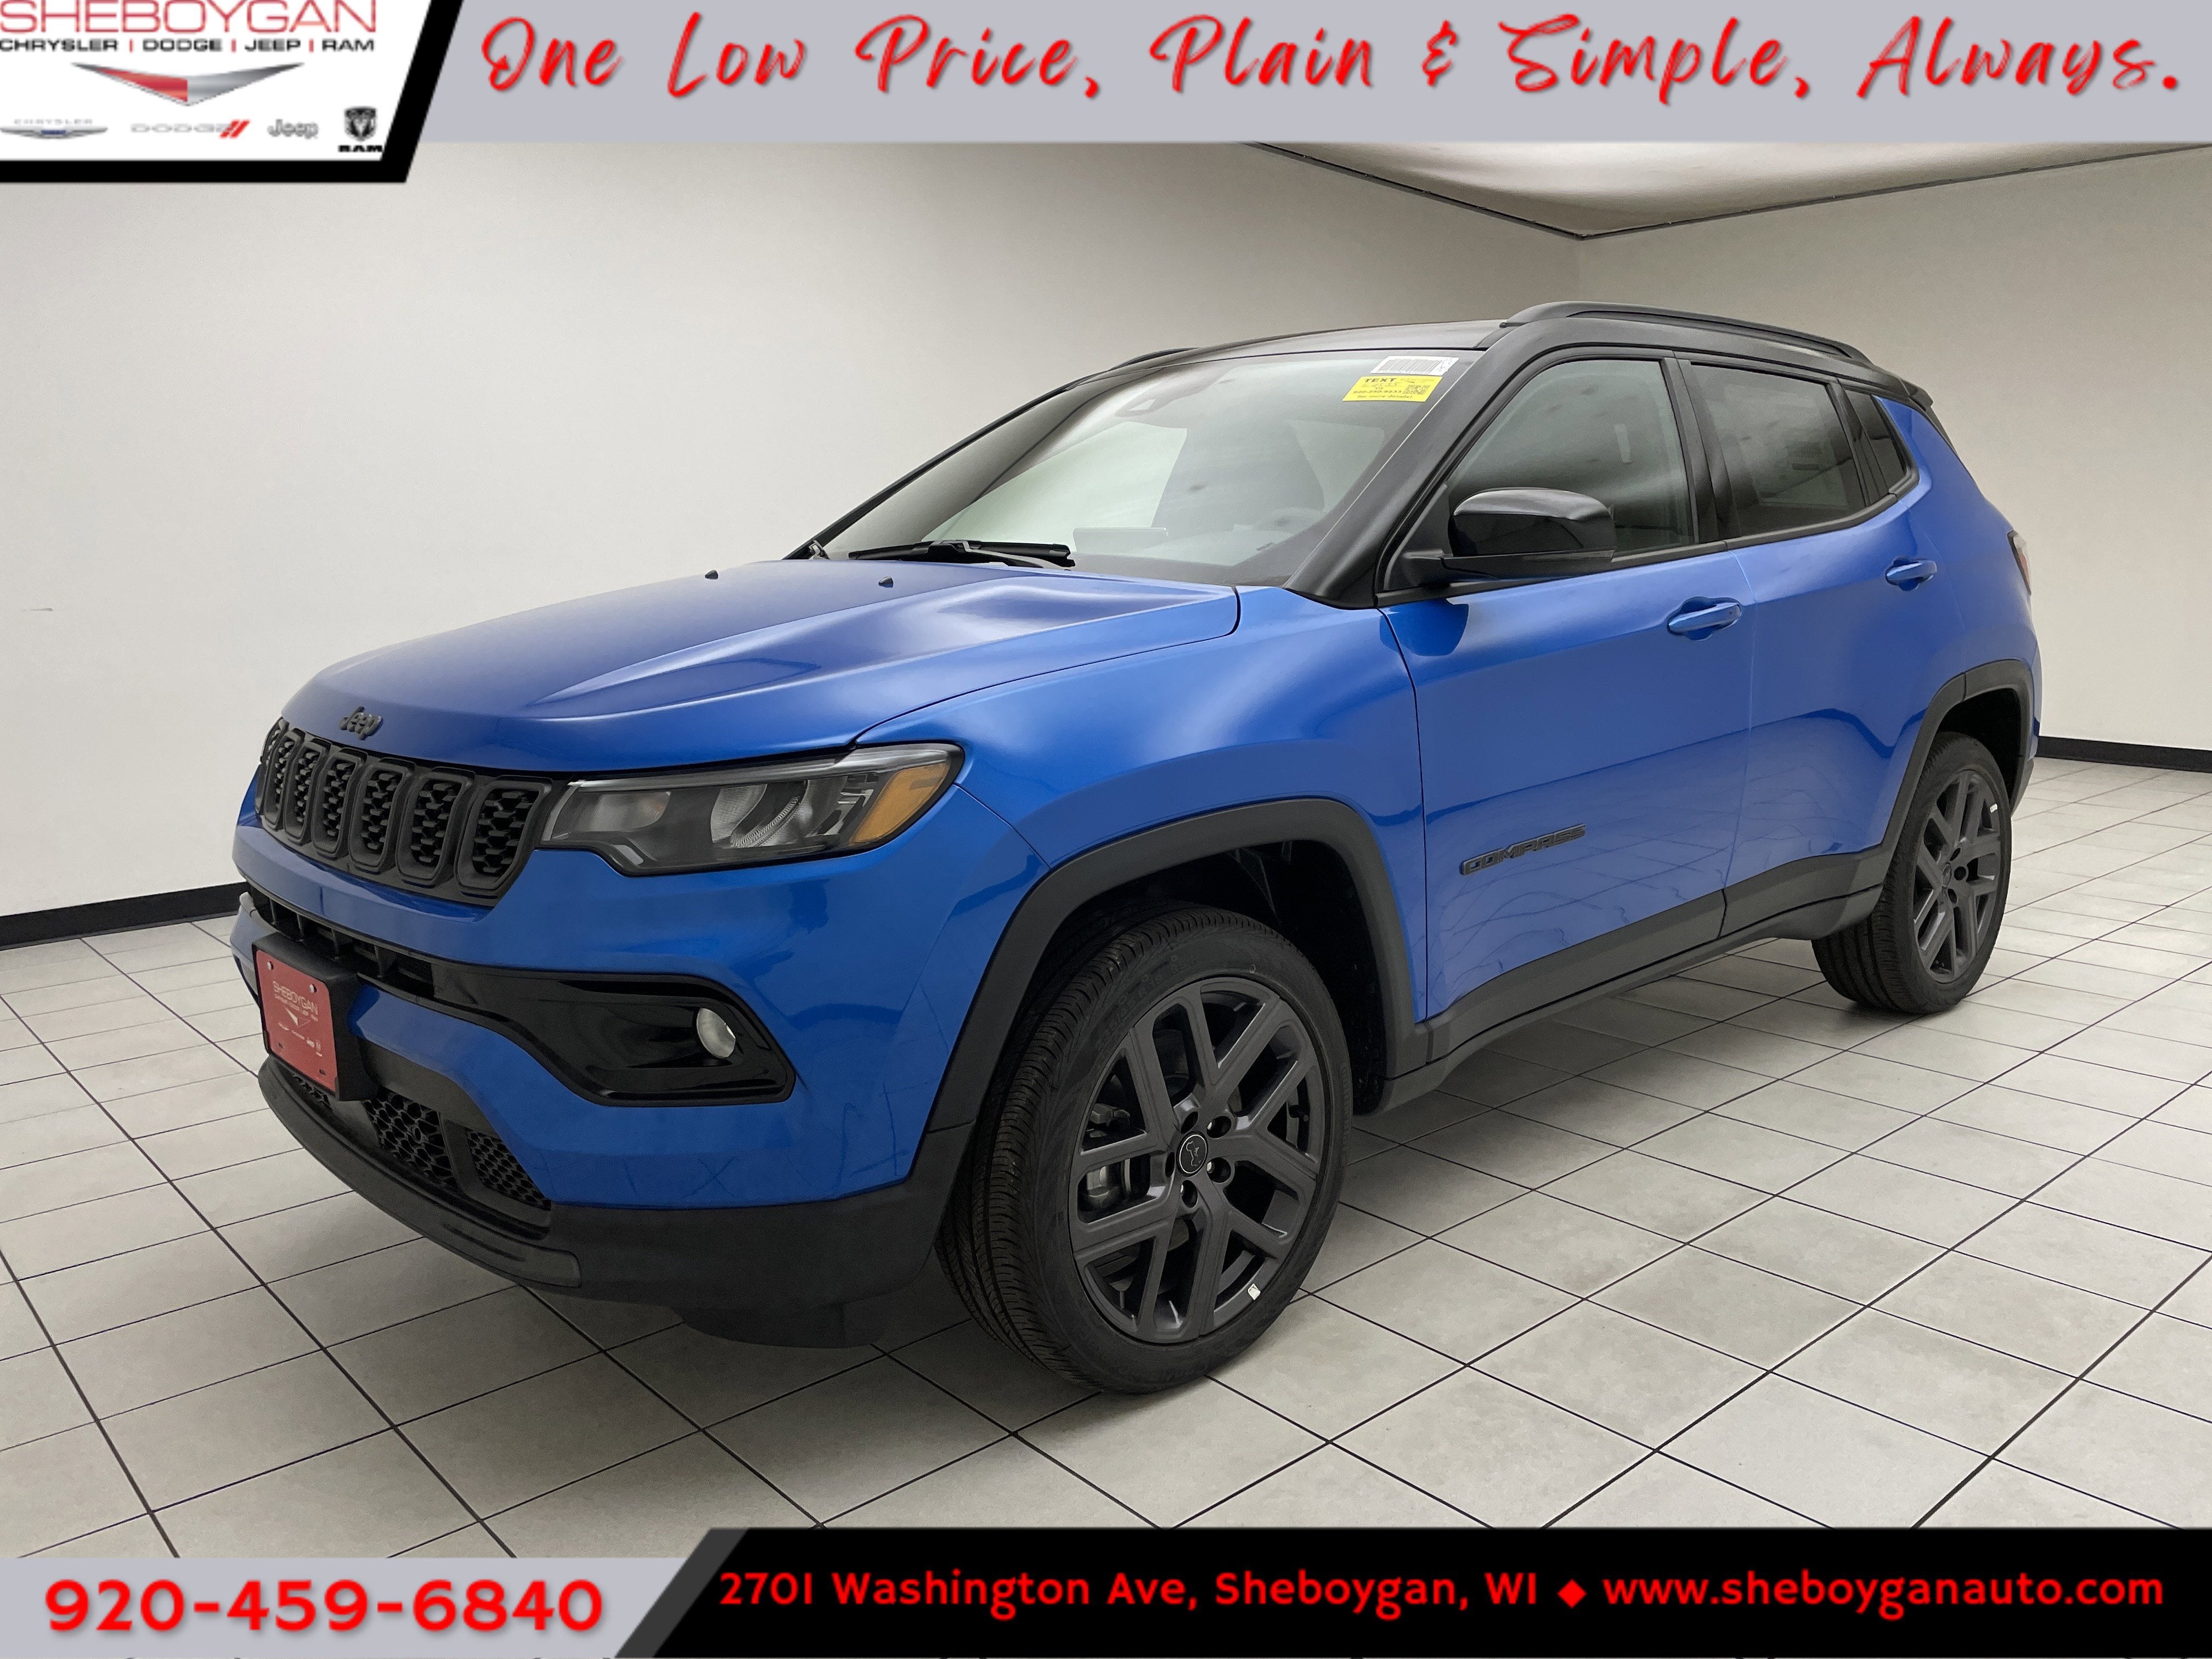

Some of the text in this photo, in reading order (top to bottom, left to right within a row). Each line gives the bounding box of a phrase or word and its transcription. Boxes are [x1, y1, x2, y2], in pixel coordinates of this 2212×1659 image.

[340, 706, 383, 741] Jeep
[1459, 823, 1586, 876] COMPASS
[273, 980, 318, 1015] SHEBOYGAN
